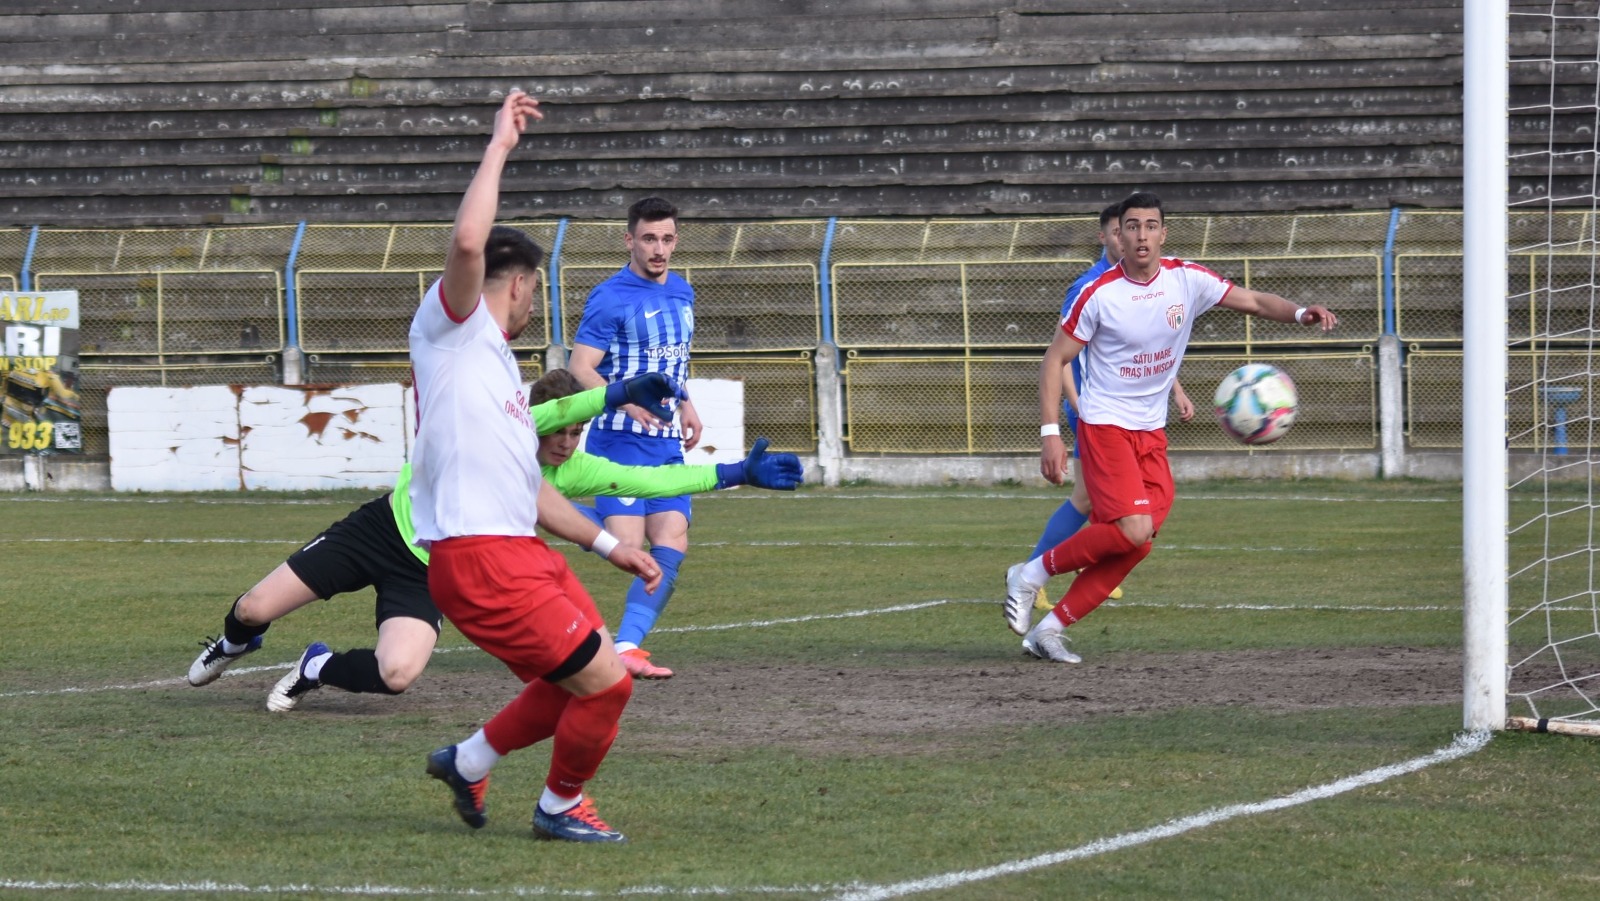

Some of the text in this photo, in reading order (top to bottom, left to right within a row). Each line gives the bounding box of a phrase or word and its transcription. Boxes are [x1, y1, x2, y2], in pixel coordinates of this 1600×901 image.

[1132, 291, 1164, 301] GIVOVA
[0, 326, 60, 357] RI
[14, 357, 57, 371] STOP
[1132, 346, 1172, 365] SATU MARE
[8, 421, 53, 450] 933
